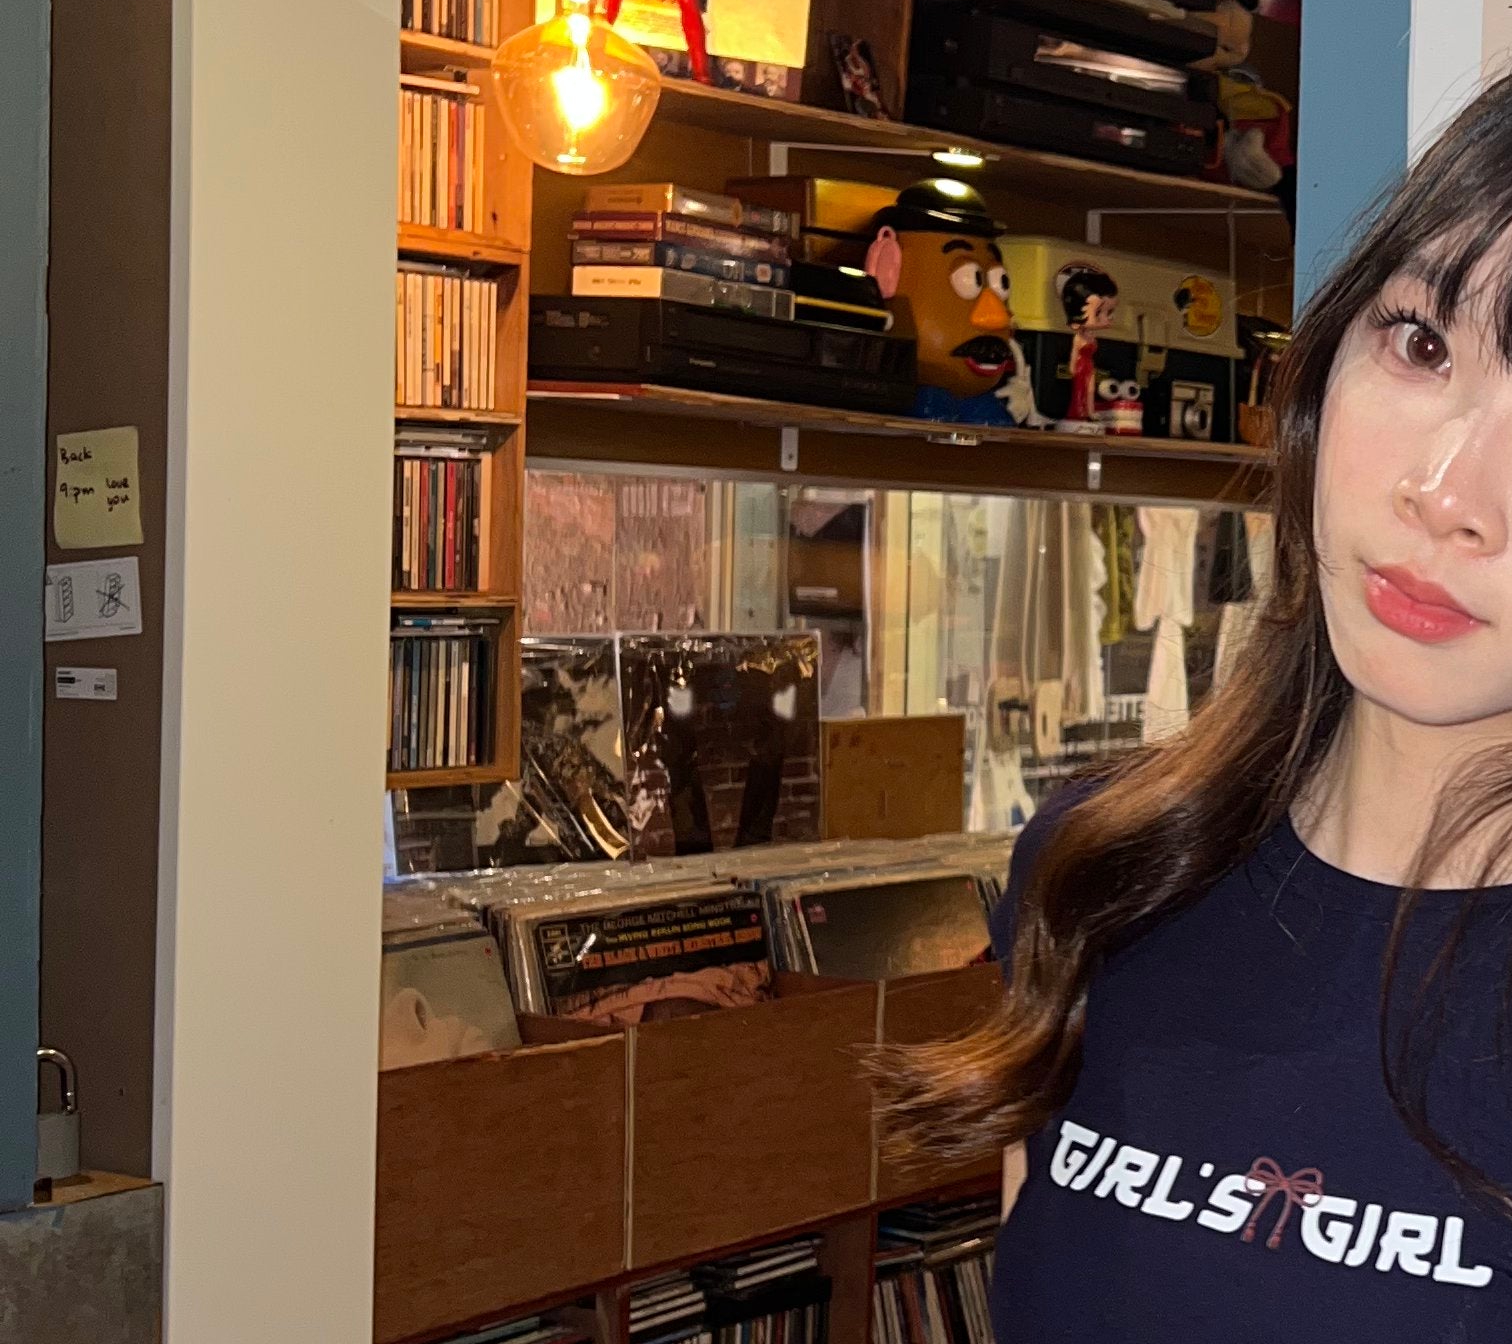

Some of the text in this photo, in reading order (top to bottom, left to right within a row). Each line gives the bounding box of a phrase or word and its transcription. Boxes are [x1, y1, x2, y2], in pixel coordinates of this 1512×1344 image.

[60, 446, 92, 464] Back
[1049, 1120, 1494, 1288] GIRL'S GIRL
